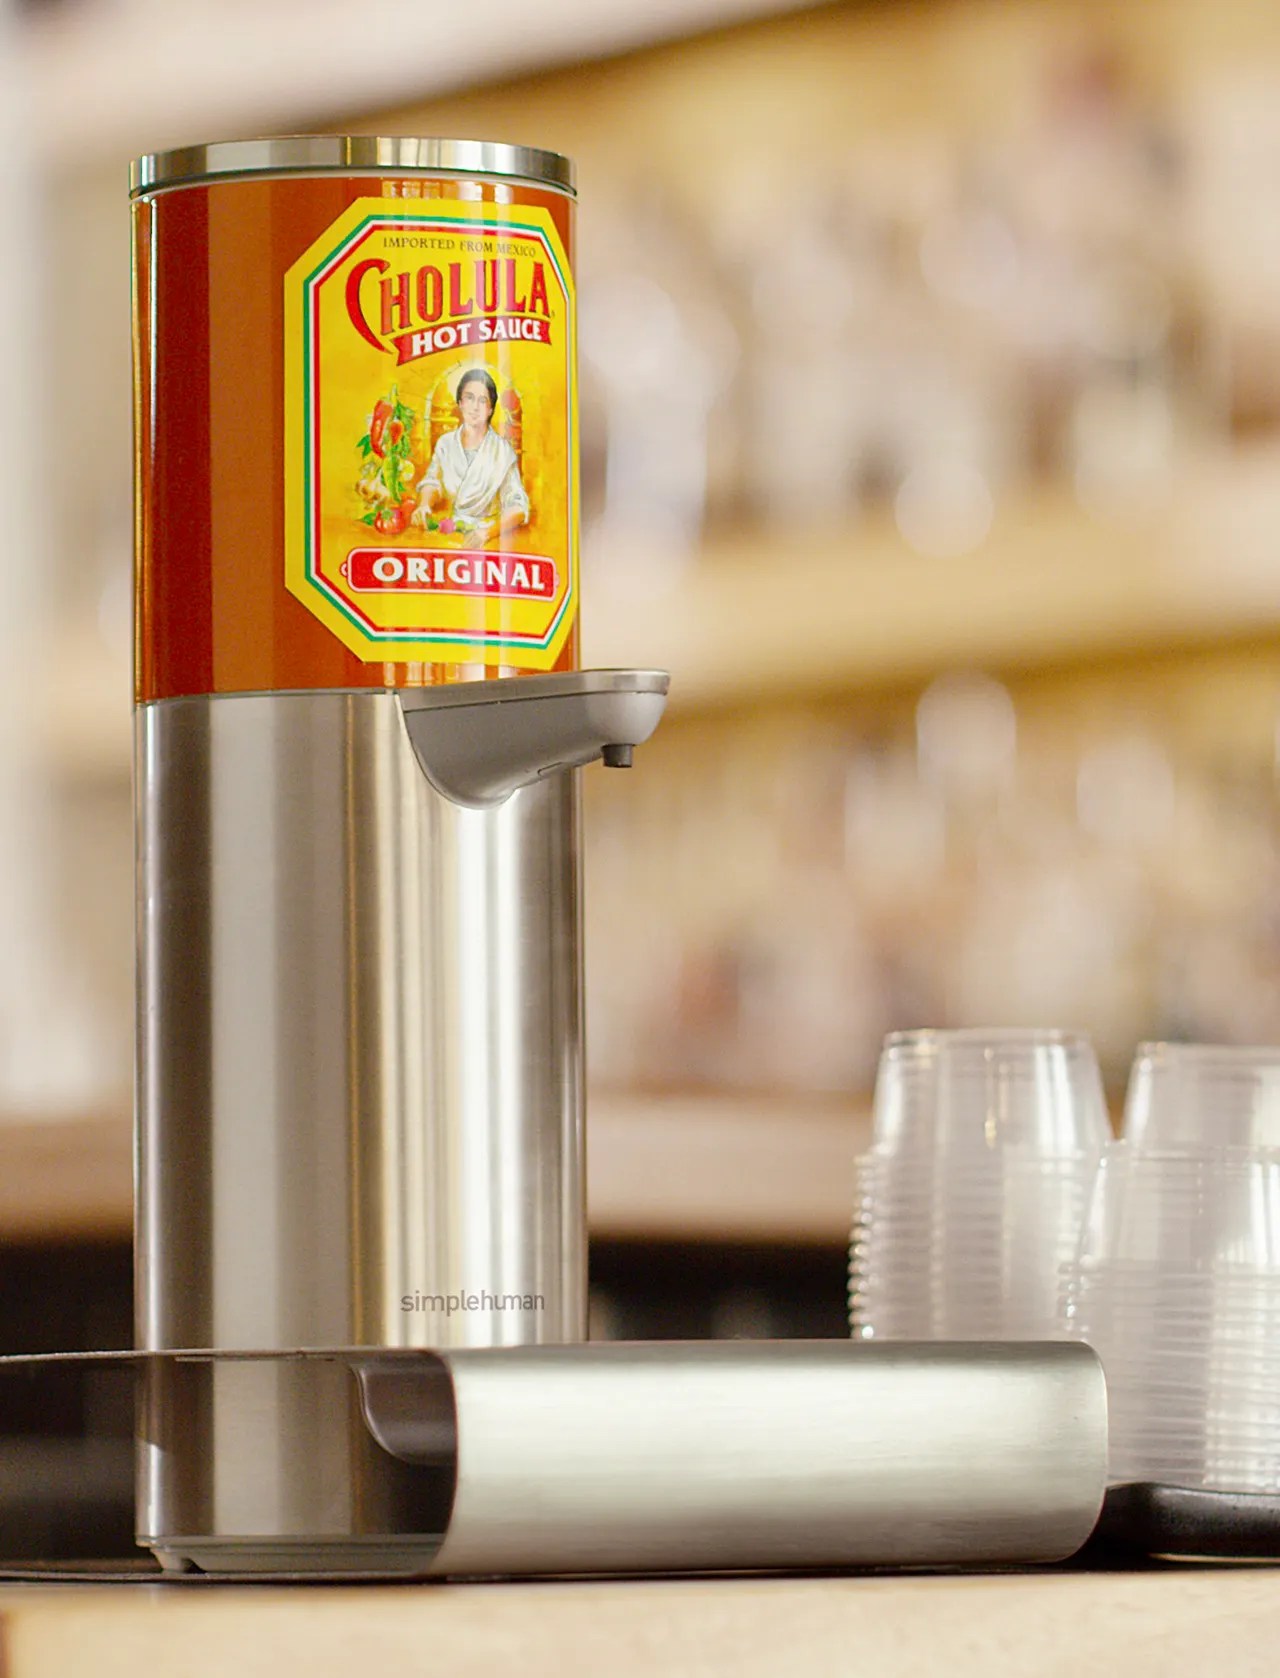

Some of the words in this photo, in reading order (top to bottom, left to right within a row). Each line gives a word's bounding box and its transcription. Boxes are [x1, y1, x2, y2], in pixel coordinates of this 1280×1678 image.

[383, 237, 455, 250] IMPORTED
[459, 240, 493, 253] FROM
[496, 243, 536, 257] MEXICO
[345, 258, 551, 355] CHOLULA
[411, 322, 471, 357] HOT
[478, 318, 542, 341] SAUCE
[372, 556, 545, 590] ORIGINAL
[400, 1289, 545, 1317] simplehuman
